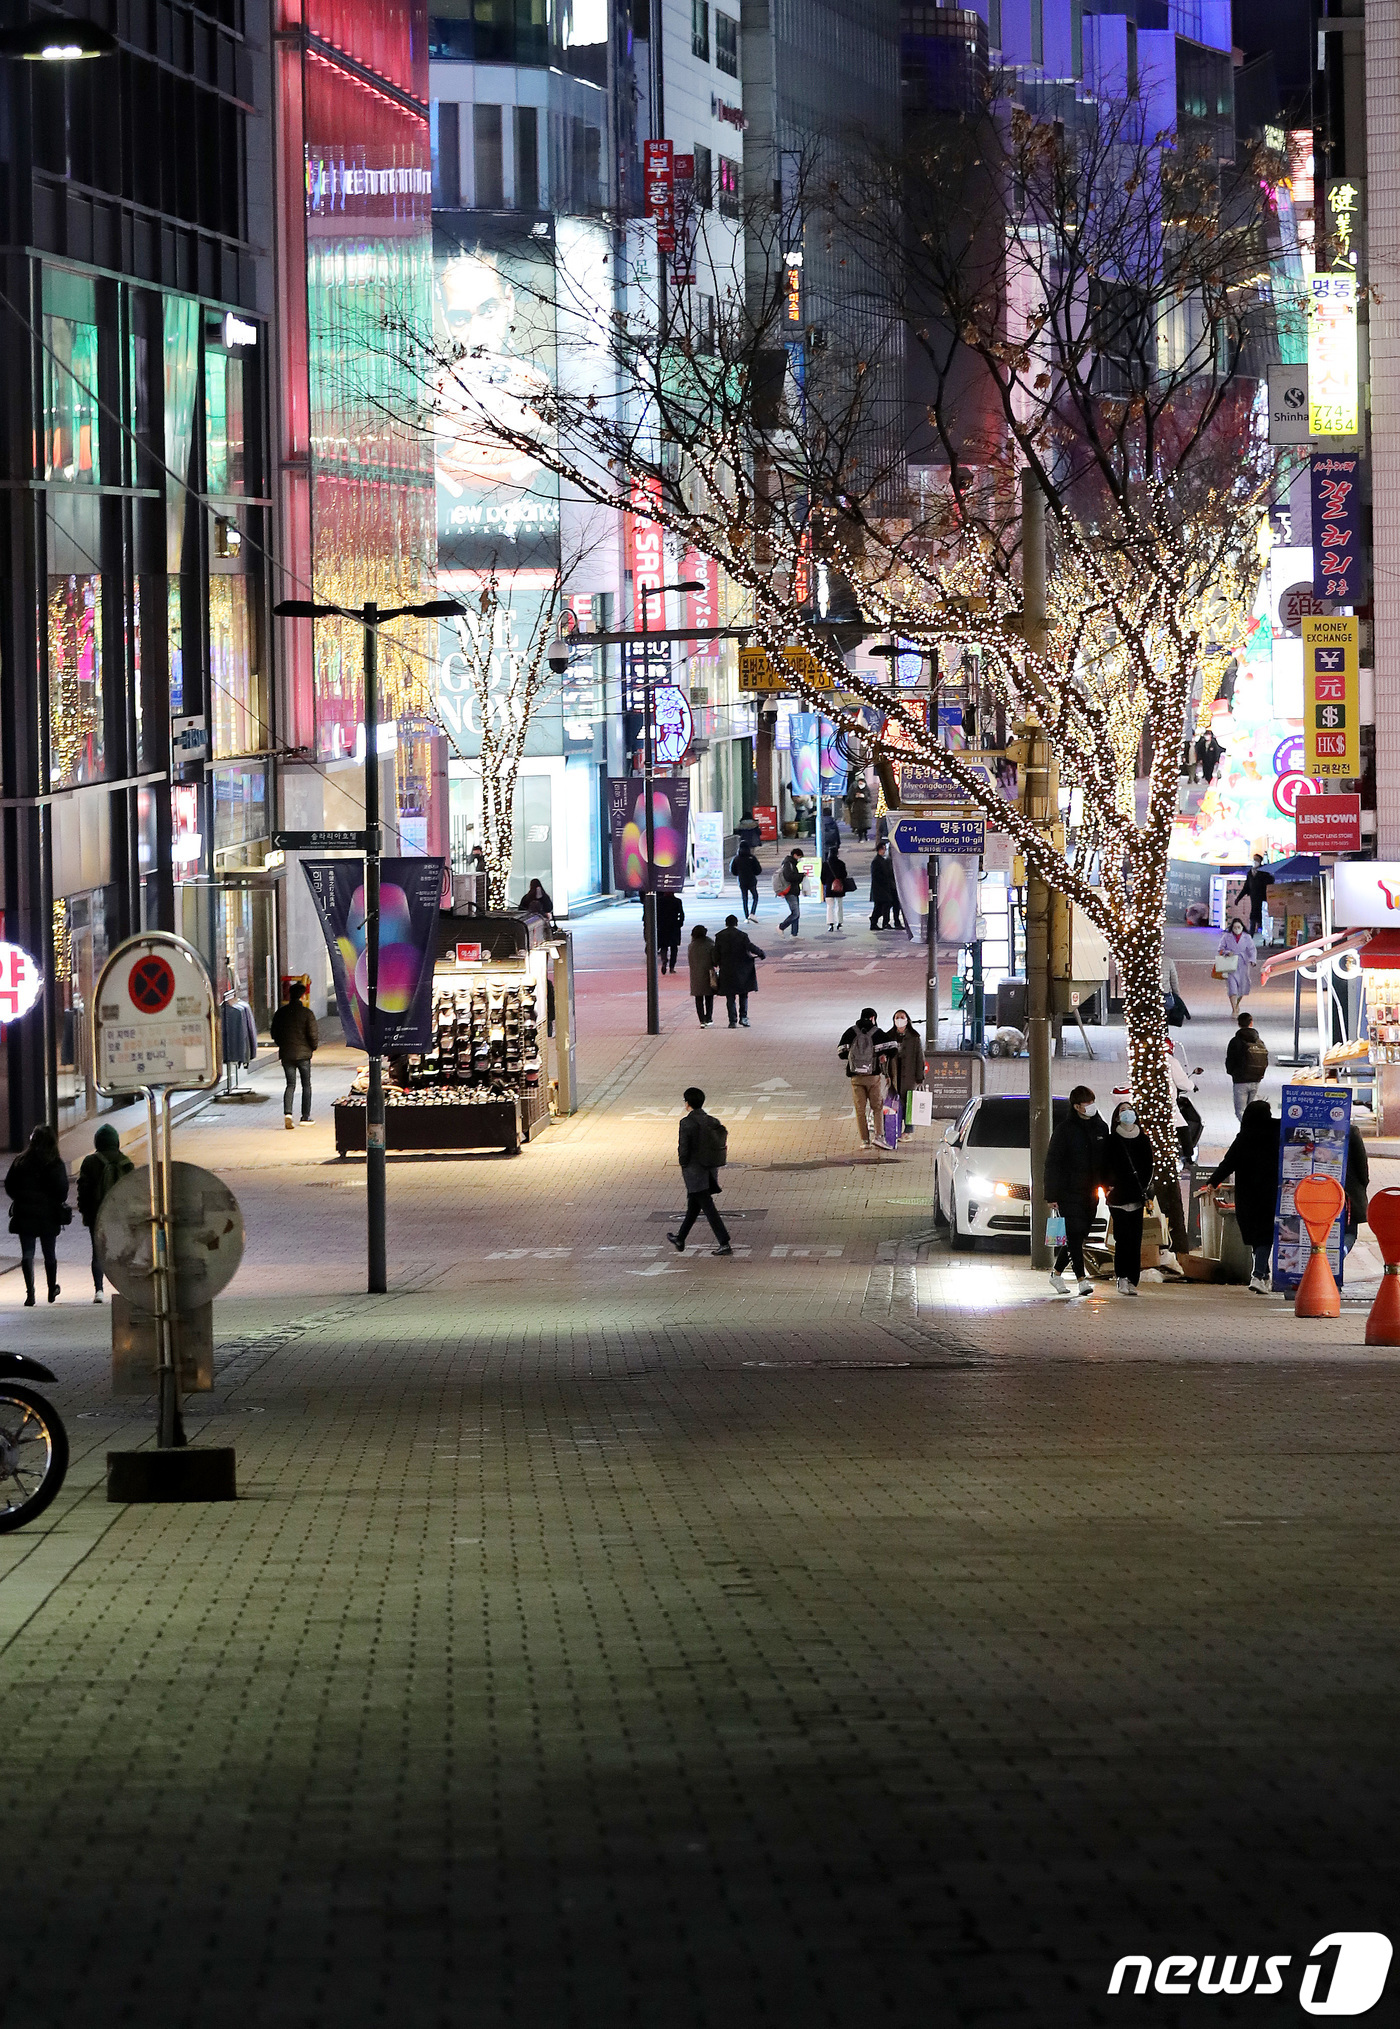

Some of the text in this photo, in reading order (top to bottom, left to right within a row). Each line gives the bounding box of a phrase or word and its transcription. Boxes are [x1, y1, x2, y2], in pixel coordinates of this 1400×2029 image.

[1312, 279, 1352, 298] 명동
[1316, 303, 1353, 395] 부동산
[1274, 412, 1309, 422] Shinha
[1313, 405, 1350, 418] 774-
[1313, 419, 1354, 431] 5454
[1313, 459, 1356, 475] 사주카페
[1318, 479, 1353, 577] 갤러리
[1325, 579, 1349, 596] 3층
[453, 609, 519, 649] WE
[1314, 623, 1348, 632] MONEY
[1306, 633, 1352, 643] EXCHANGE
[441, 651, 528, 693] GOT
[1319, 678, 1342, 698] 元
[1322, 705, 1339, 728] $
[1317, 735, 1345, 755] HK$
[1312, 763, 1350, 775] 고래환전
[903, 781, 953, 790] Myeongdong
[1298, 813, 1357, 824] LENS TOWN
[940, 822, 983, 834] 명동10길
[910, 835, 983, 845] Myeongdong 10-gil
